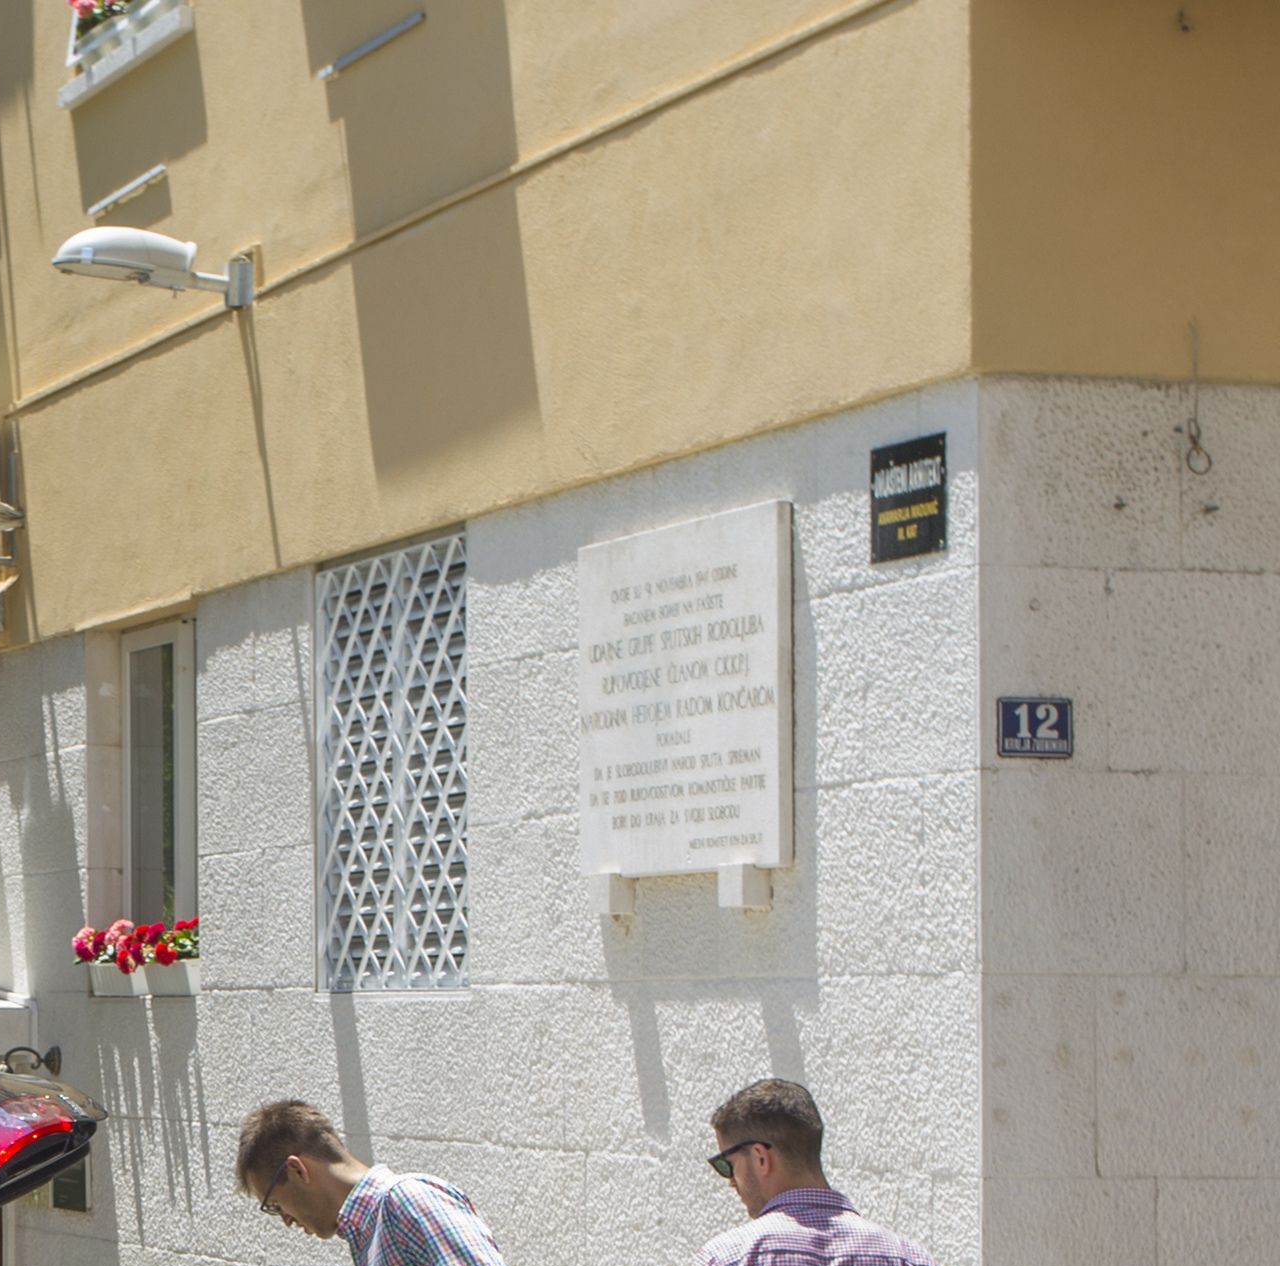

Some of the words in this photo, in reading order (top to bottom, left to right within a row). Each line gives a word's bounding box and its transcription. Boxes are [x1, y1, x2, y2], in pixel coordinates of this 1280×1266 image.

[708, 615, 764, 643] RODOLJUBA
[676, 695, 712, 717] RADOM
[1014, 703, 1059, 739] 12
